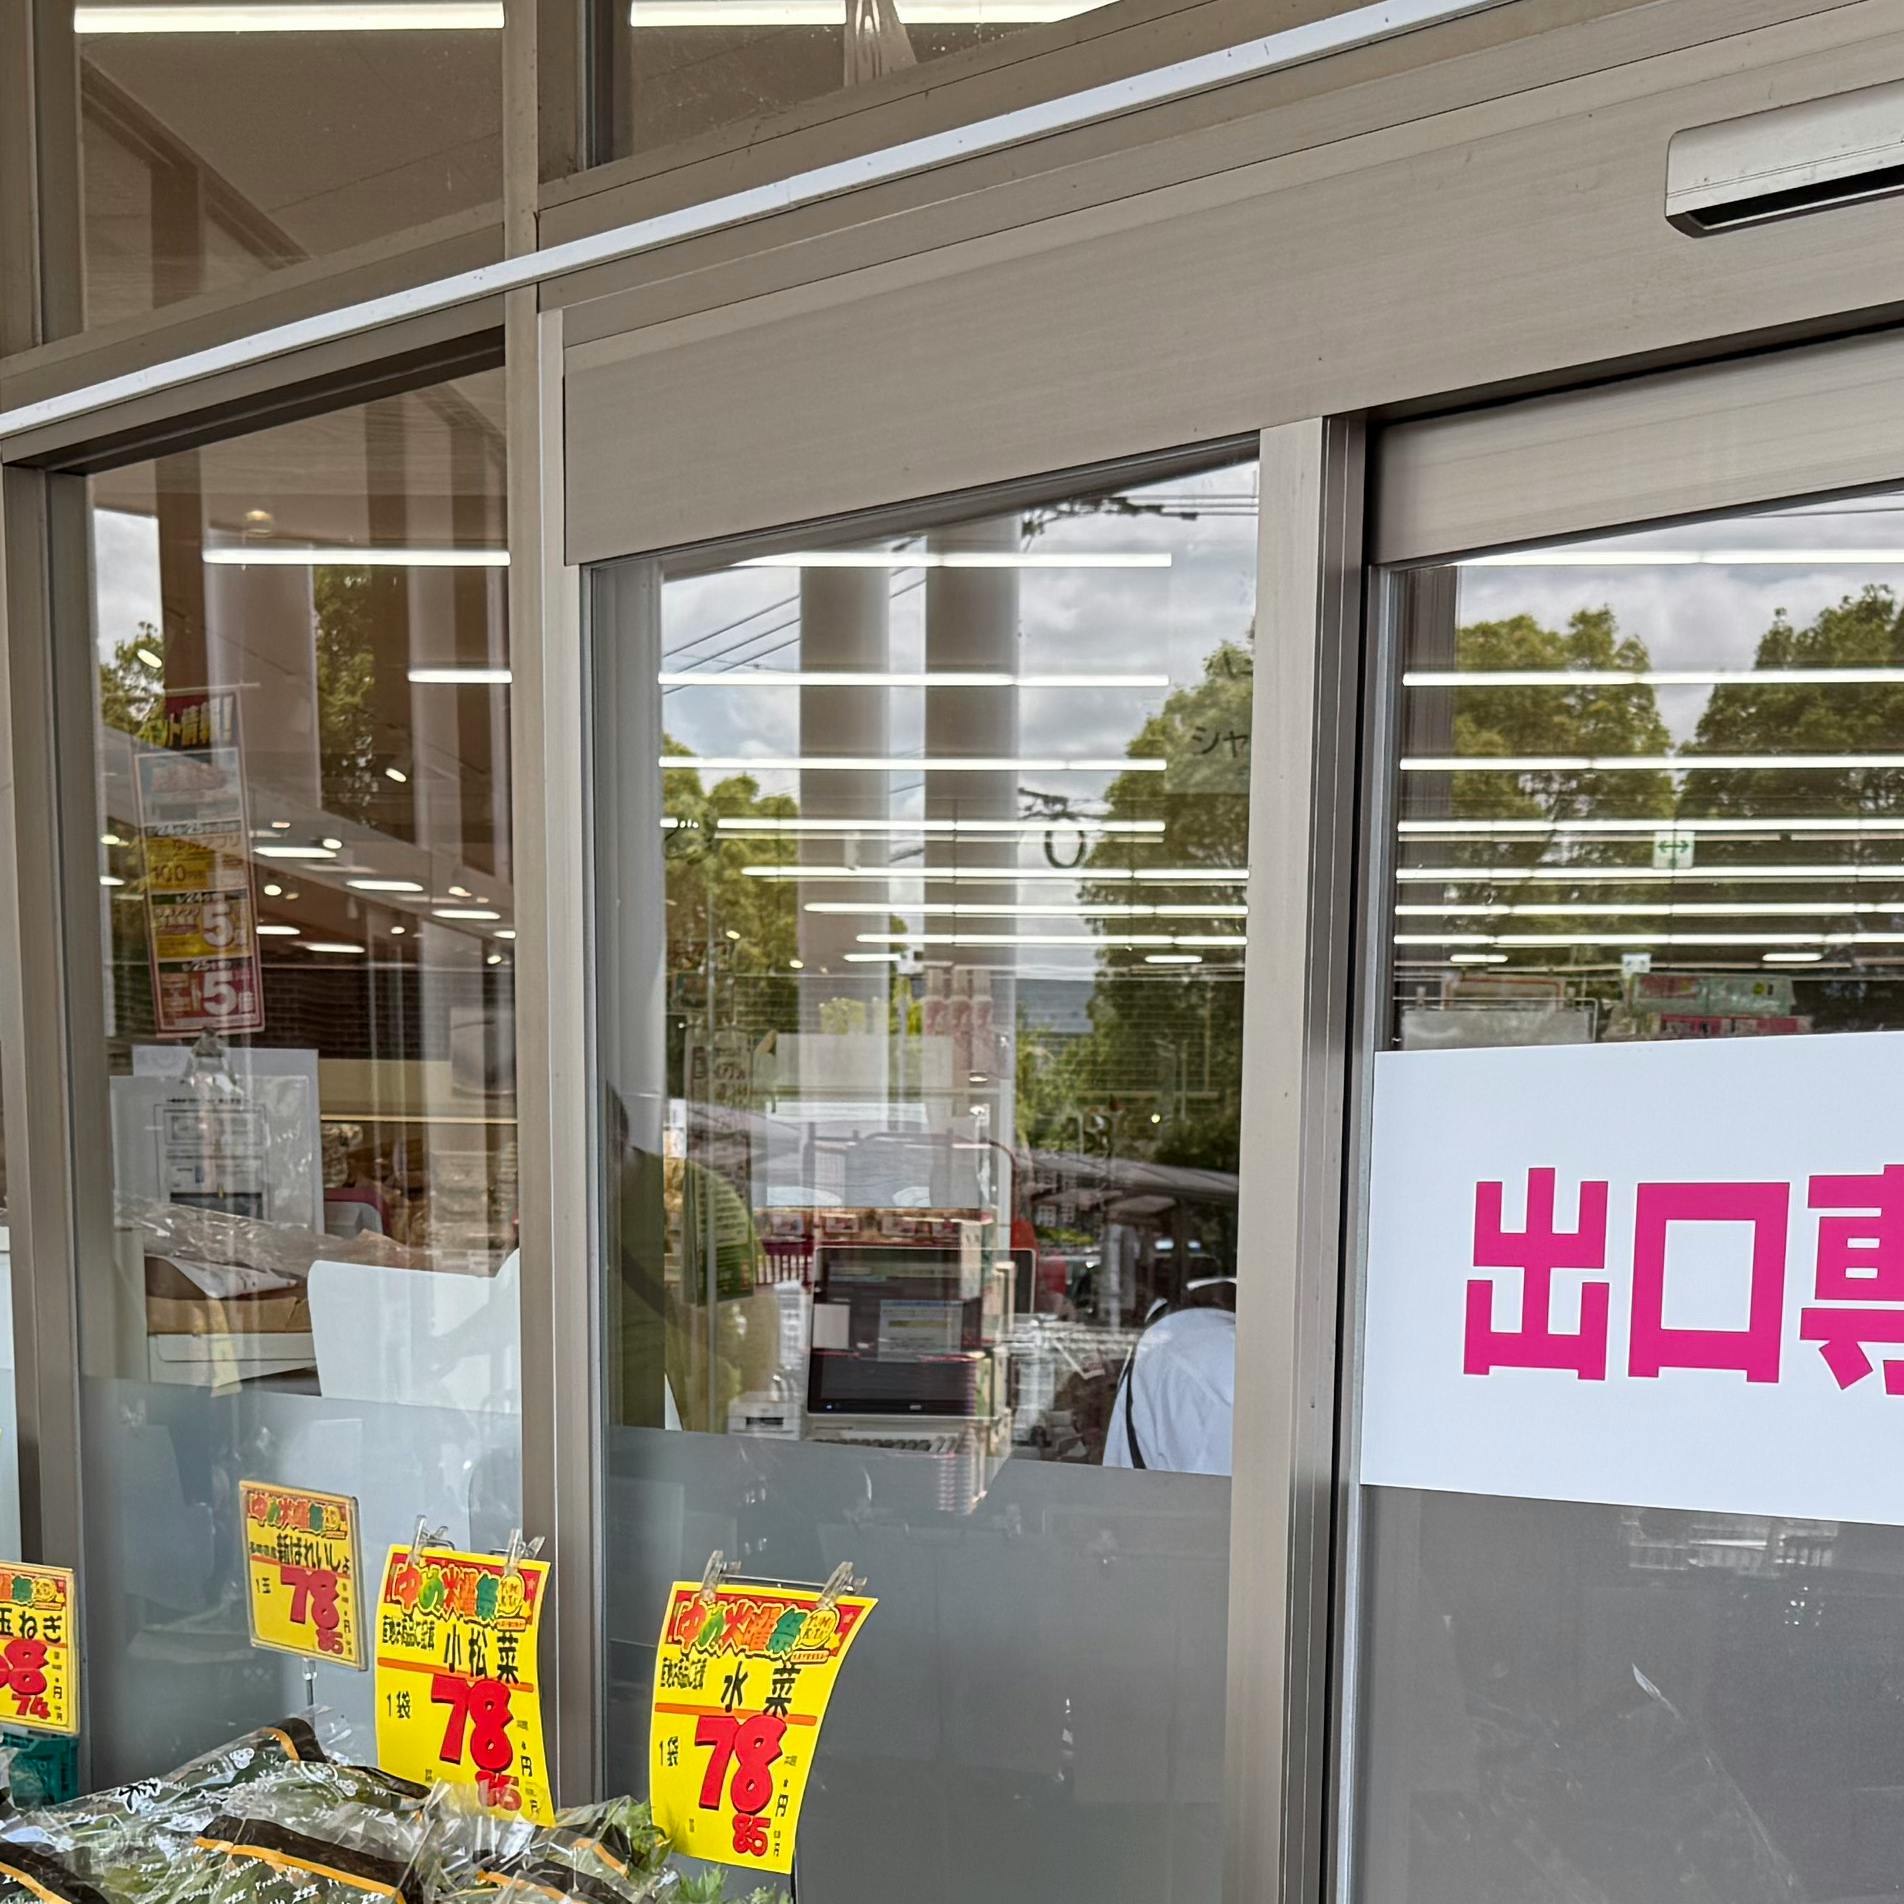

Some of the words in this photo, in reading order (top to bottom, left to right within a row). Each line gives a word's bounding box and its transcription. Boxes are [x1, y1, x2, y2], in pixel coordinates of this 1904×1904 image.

[280, 1565, 340, 1630] 78
[443, 1623, 520, 1685] 小松菜
[11, 1693, 51, 1719] 74
[719, 1660, 801, 1718] 水菜
[430, 1673, 514, 1773] 78
[694, 1714, 788, 1815] 78
[732, 1812, 771, 1857] 85
